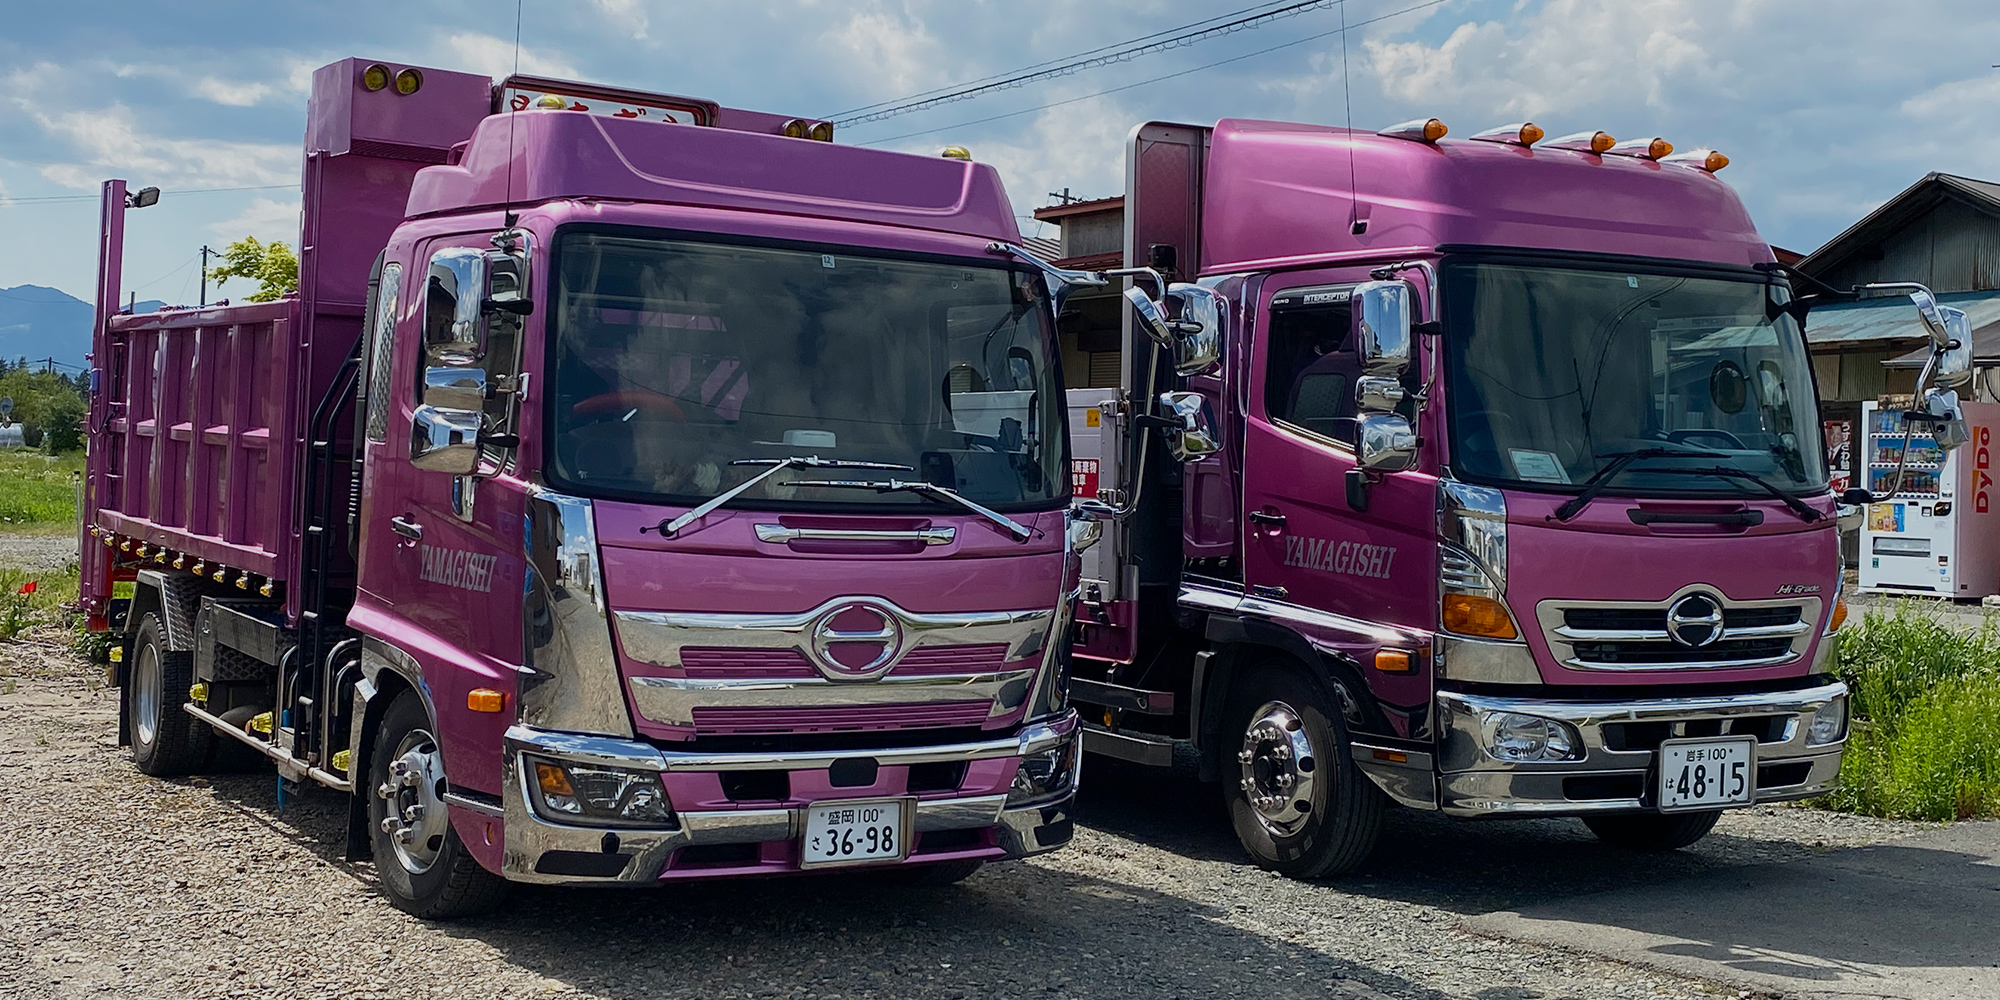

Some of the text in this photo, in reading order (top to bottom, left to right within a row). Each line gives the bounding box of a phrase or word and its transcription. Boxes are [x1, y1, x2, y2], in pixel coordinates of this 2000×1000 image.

[1303, 291, 1350, 302] INTERCEPTOR
[420, 545, 498, 593] YAMAGISHI
[1284, 535, 1397, 579] YAMAGISHI
[1665, 761, 1746, 799] は 48-15
[812, 826, 893, 856] さ 36-98
